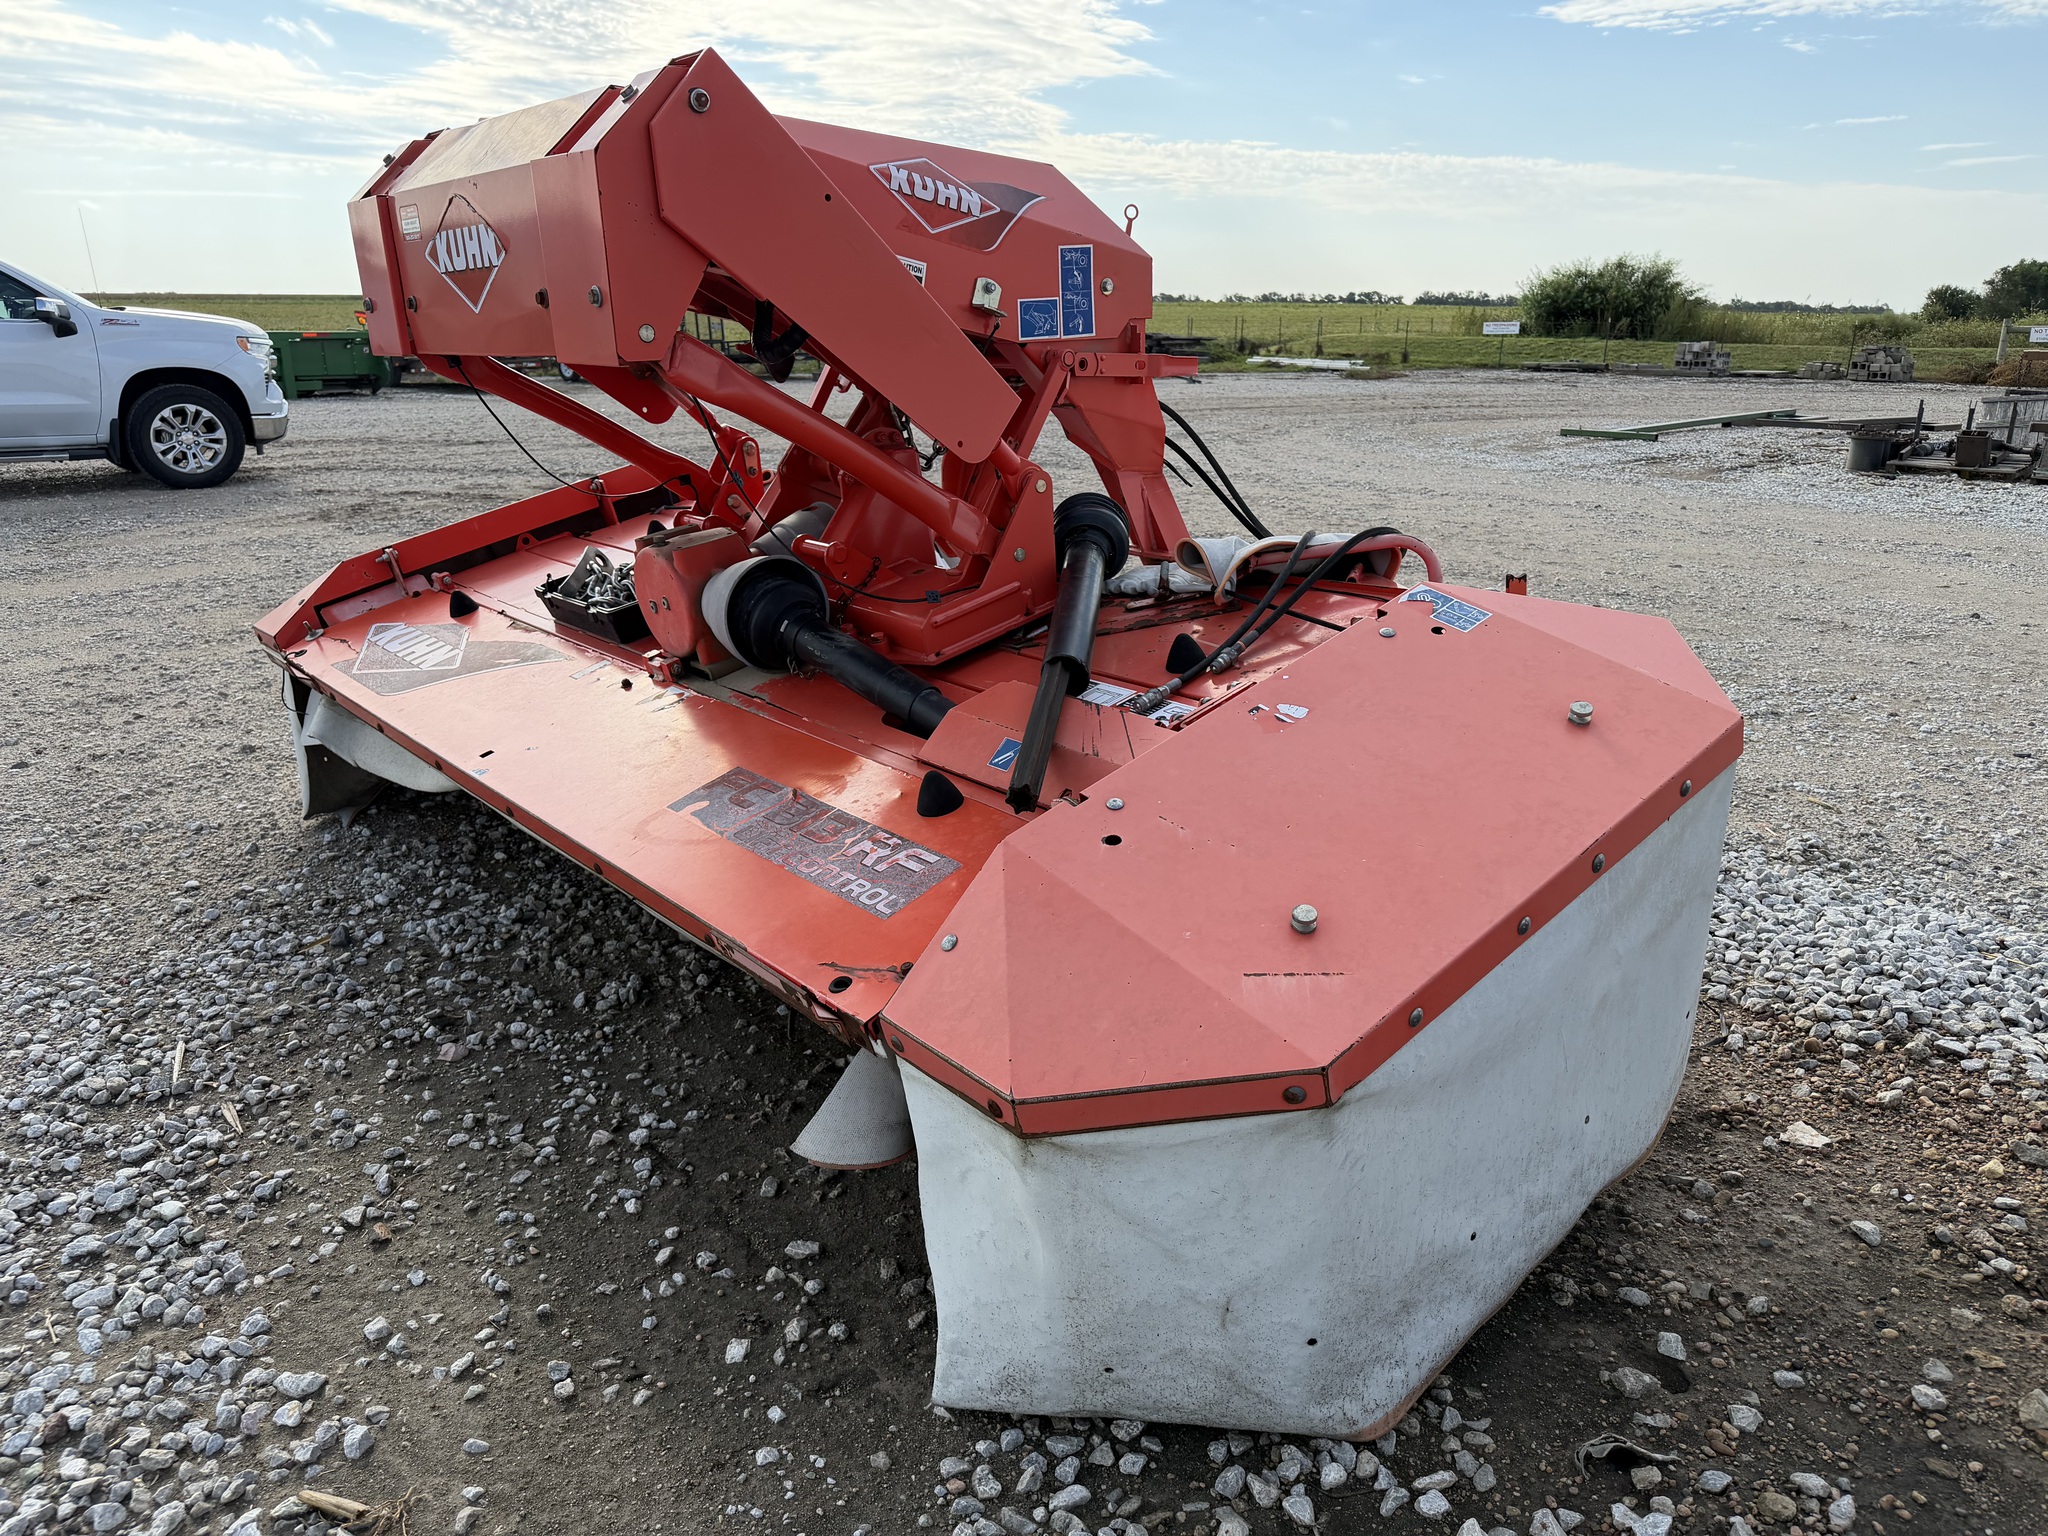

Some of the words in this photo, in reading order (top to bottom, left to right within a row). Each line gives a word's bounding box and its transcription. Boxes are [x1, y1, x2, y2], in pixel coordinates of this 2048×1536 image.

[886, 163, 983, 218] KUHN
[435, 224, 498, 274] KUHN
[370, 624, 463, 670] KUHN
[840, 831, 941, 873] RF
